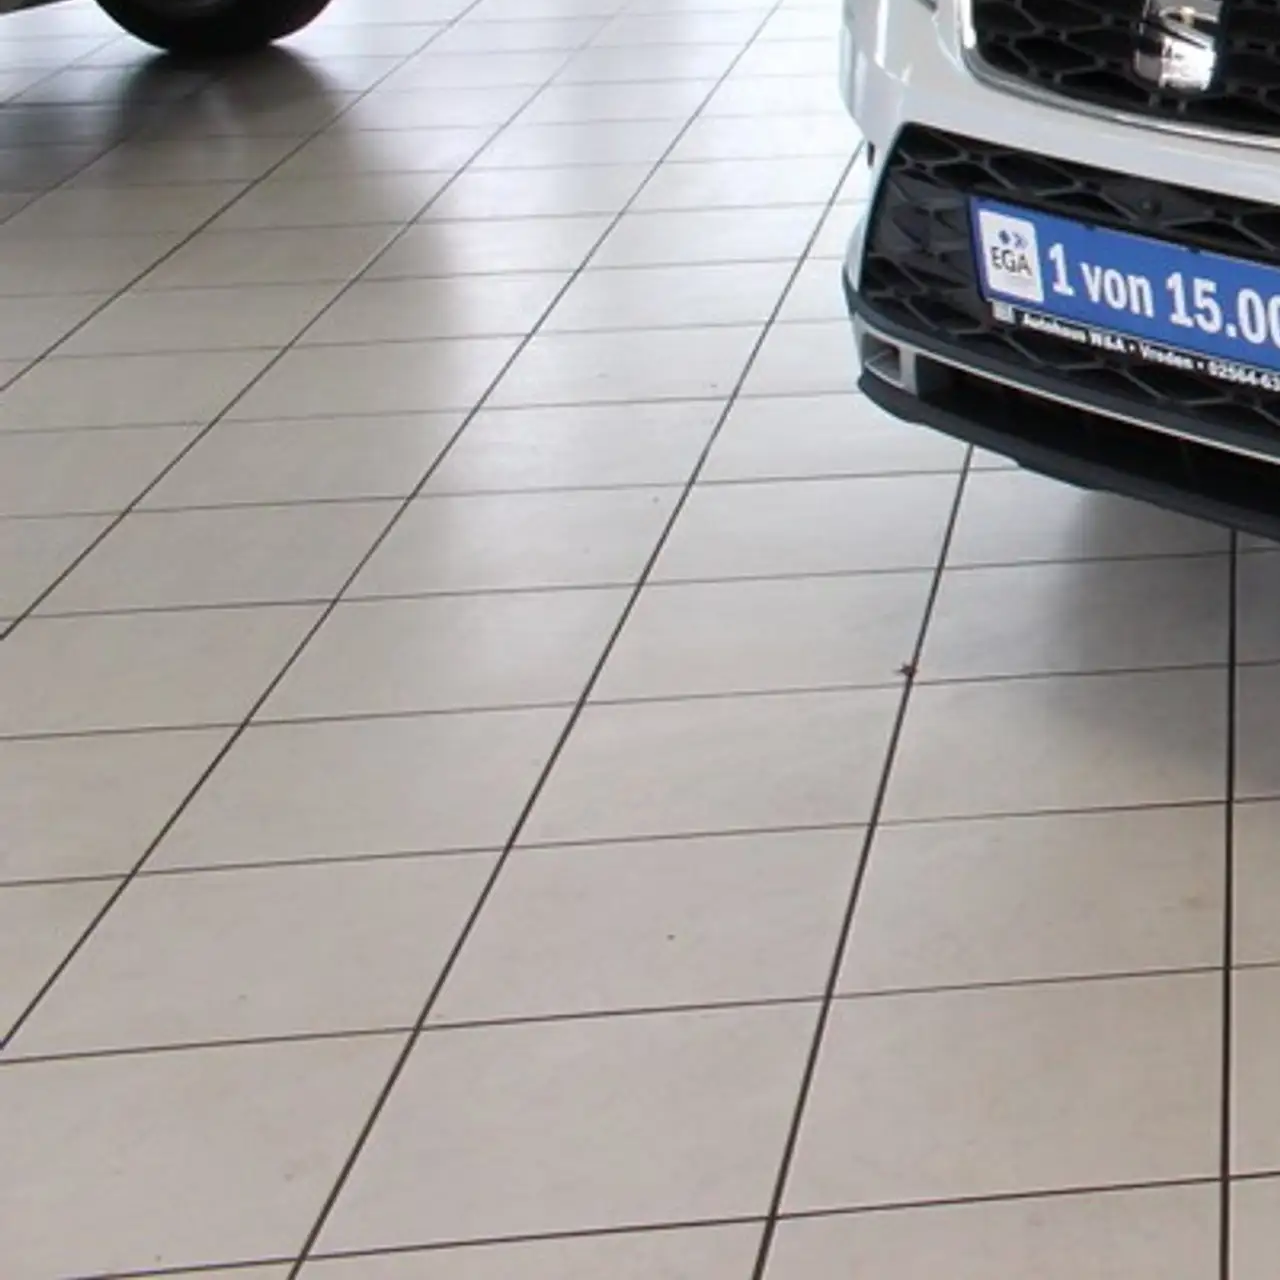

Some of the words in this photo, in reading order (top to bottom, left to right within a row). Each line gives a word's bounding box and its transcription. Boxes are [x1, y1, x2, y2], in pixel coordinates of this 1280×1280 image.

[991, 245, 1033, 277] EGA
[1048, 242, 1075, 297] 1
[1079, 261, 1155, 319] von
